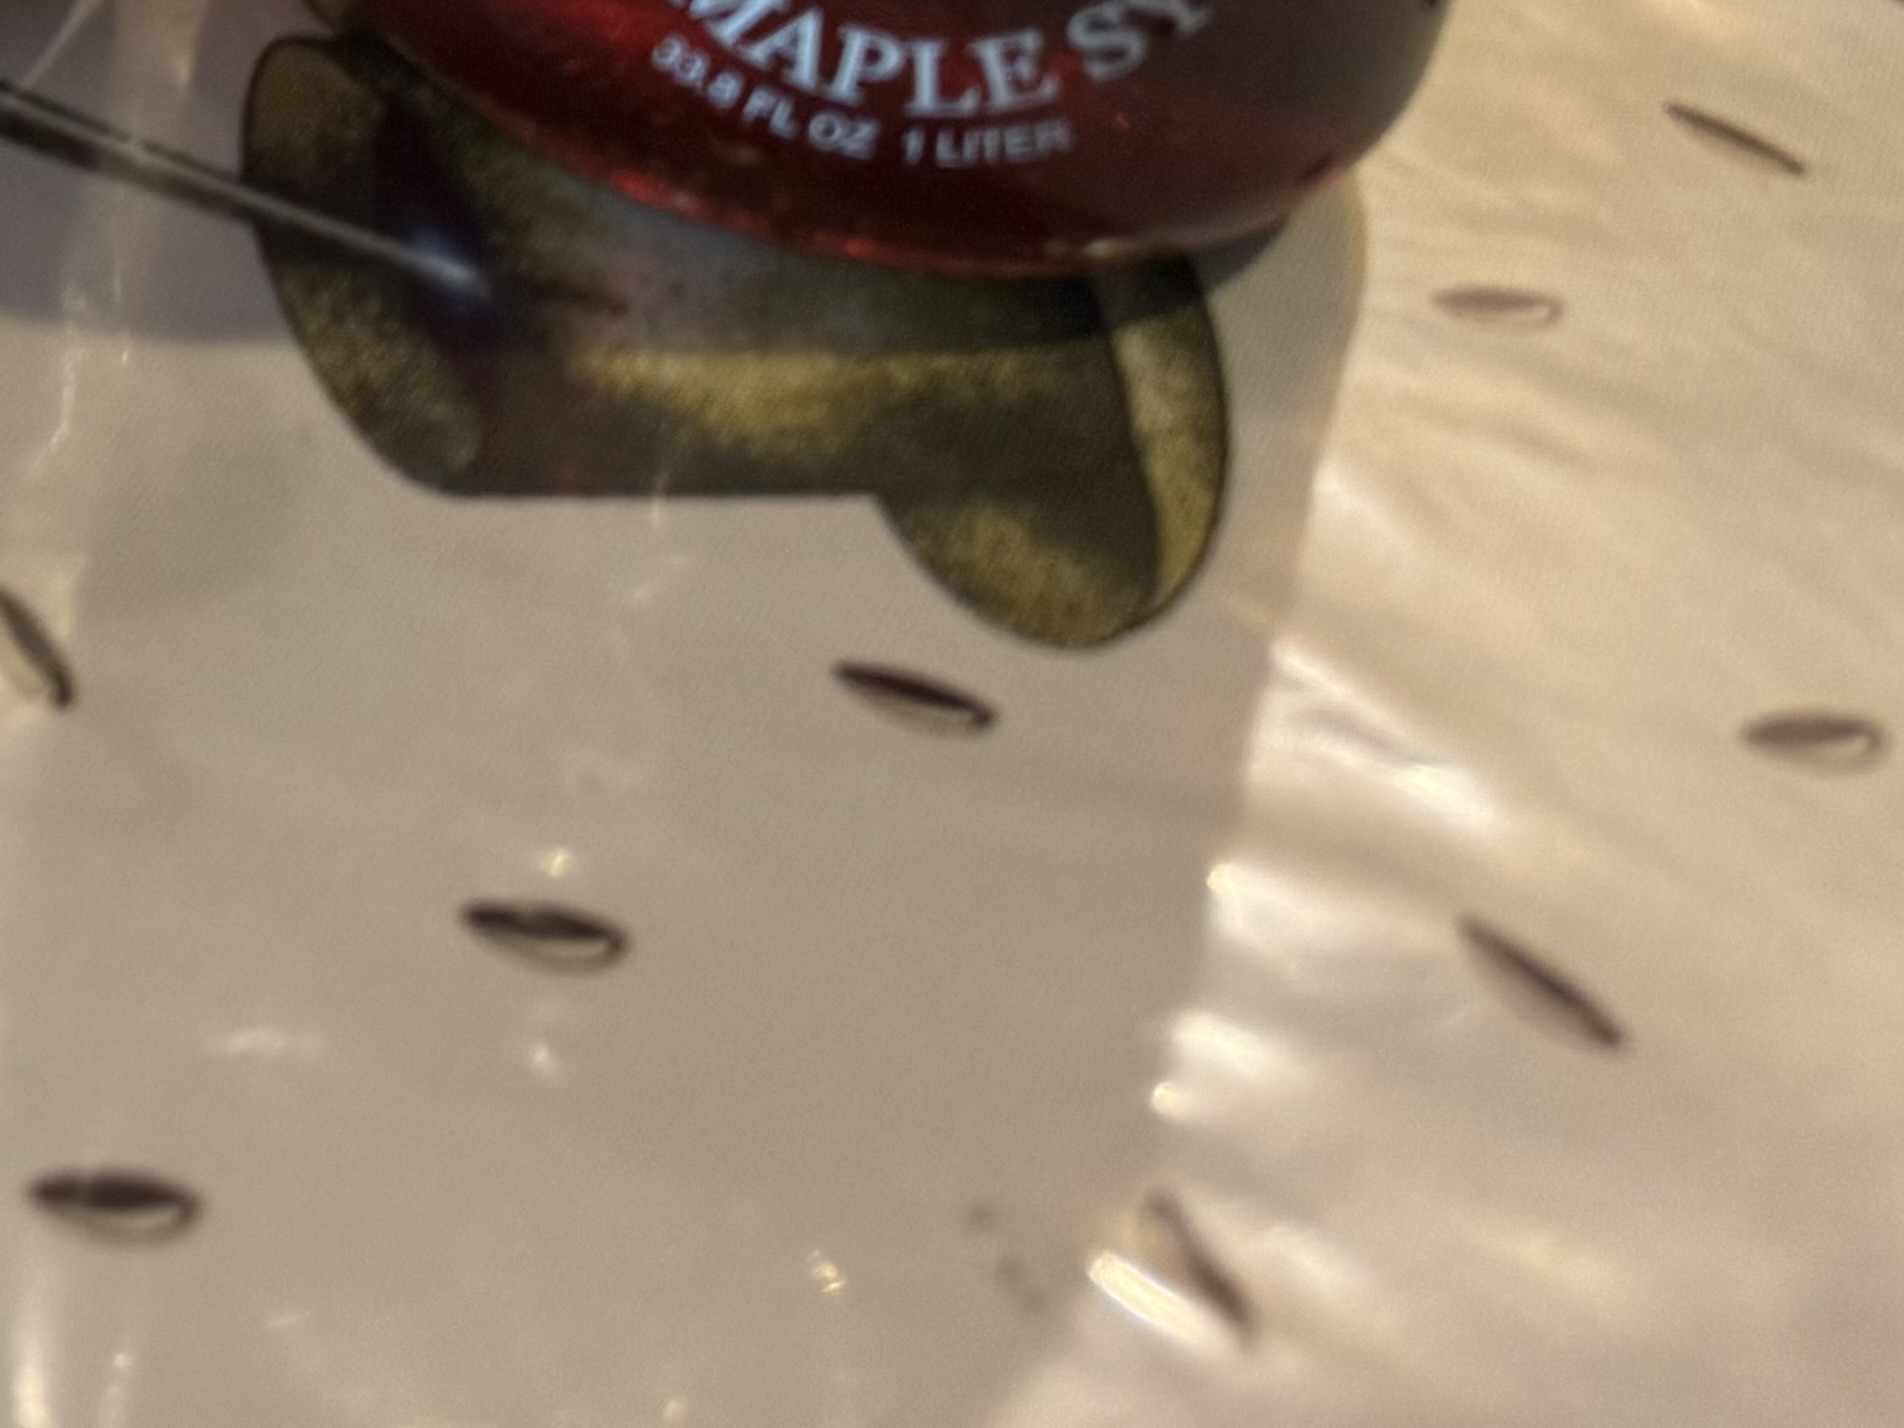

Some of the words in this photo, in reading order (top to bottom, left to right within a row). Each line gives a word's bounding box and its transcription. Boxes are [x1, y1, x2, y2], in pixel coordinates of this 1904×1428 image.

[650, 34, 745, 110] 33.8
[742, 86, 799, 142] FL
[806, 110, 883, 162] OZ
[903, 124, 926, 165] 1
[934, 117, 1075, 169] LITER
